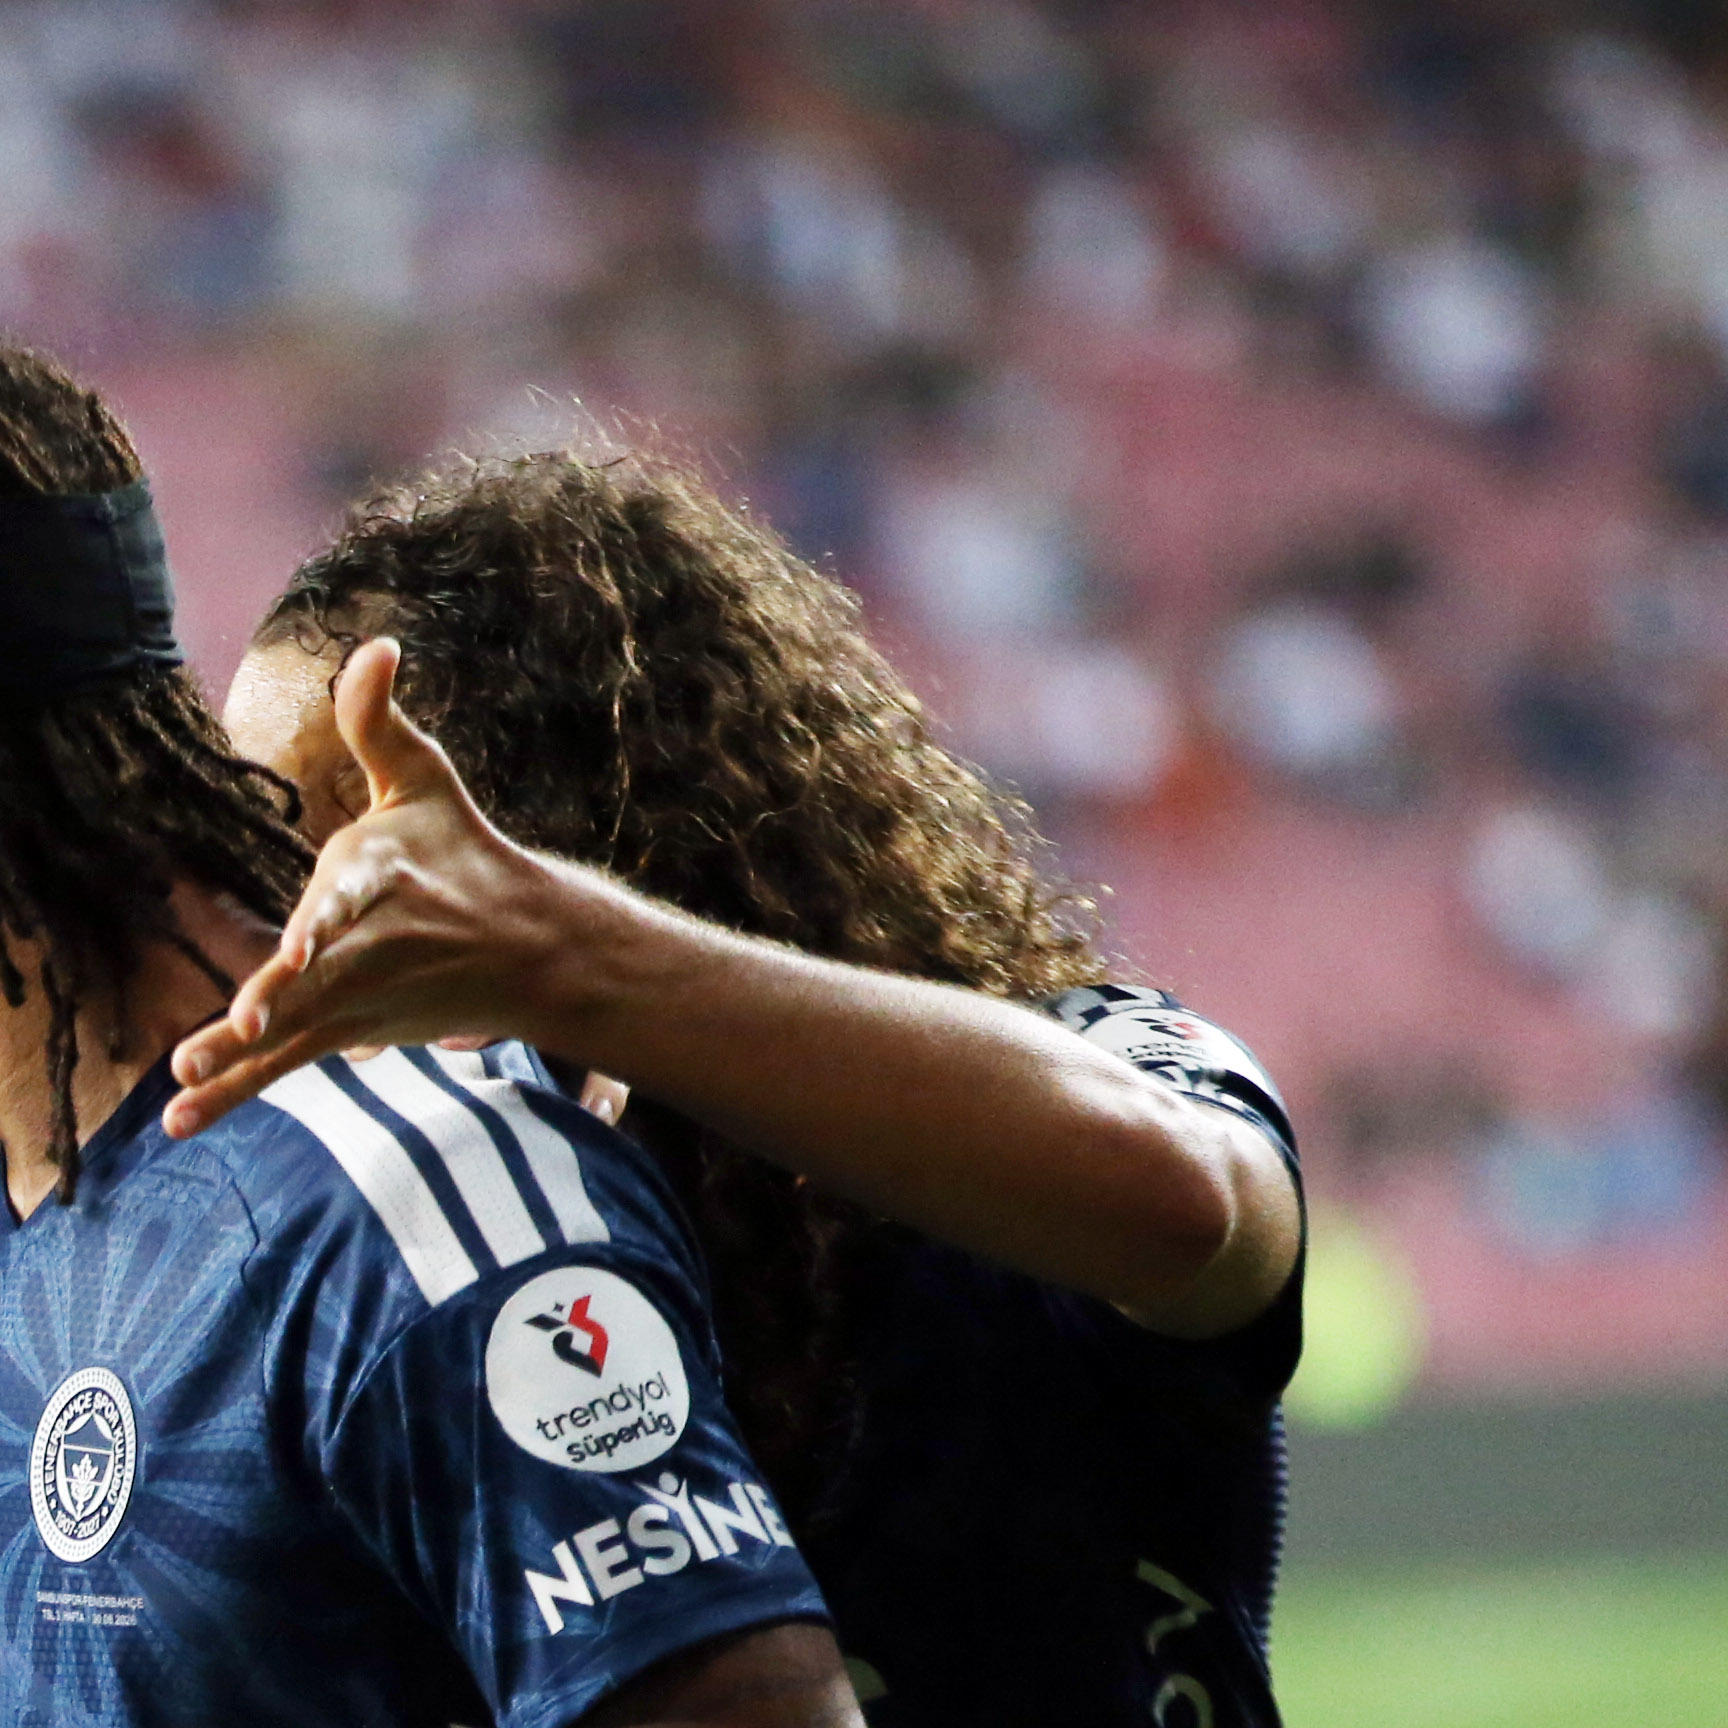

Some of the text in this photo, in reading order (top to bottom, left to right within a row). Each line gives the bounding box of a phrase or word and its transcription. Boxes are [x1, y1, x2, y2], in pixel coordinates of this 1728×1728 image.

[44, 1390, 93, 1497] FENERBAHÇE
[93, 1391, 121, 1429] SPOR
[536, 1370, 671, 1442] trendyol
